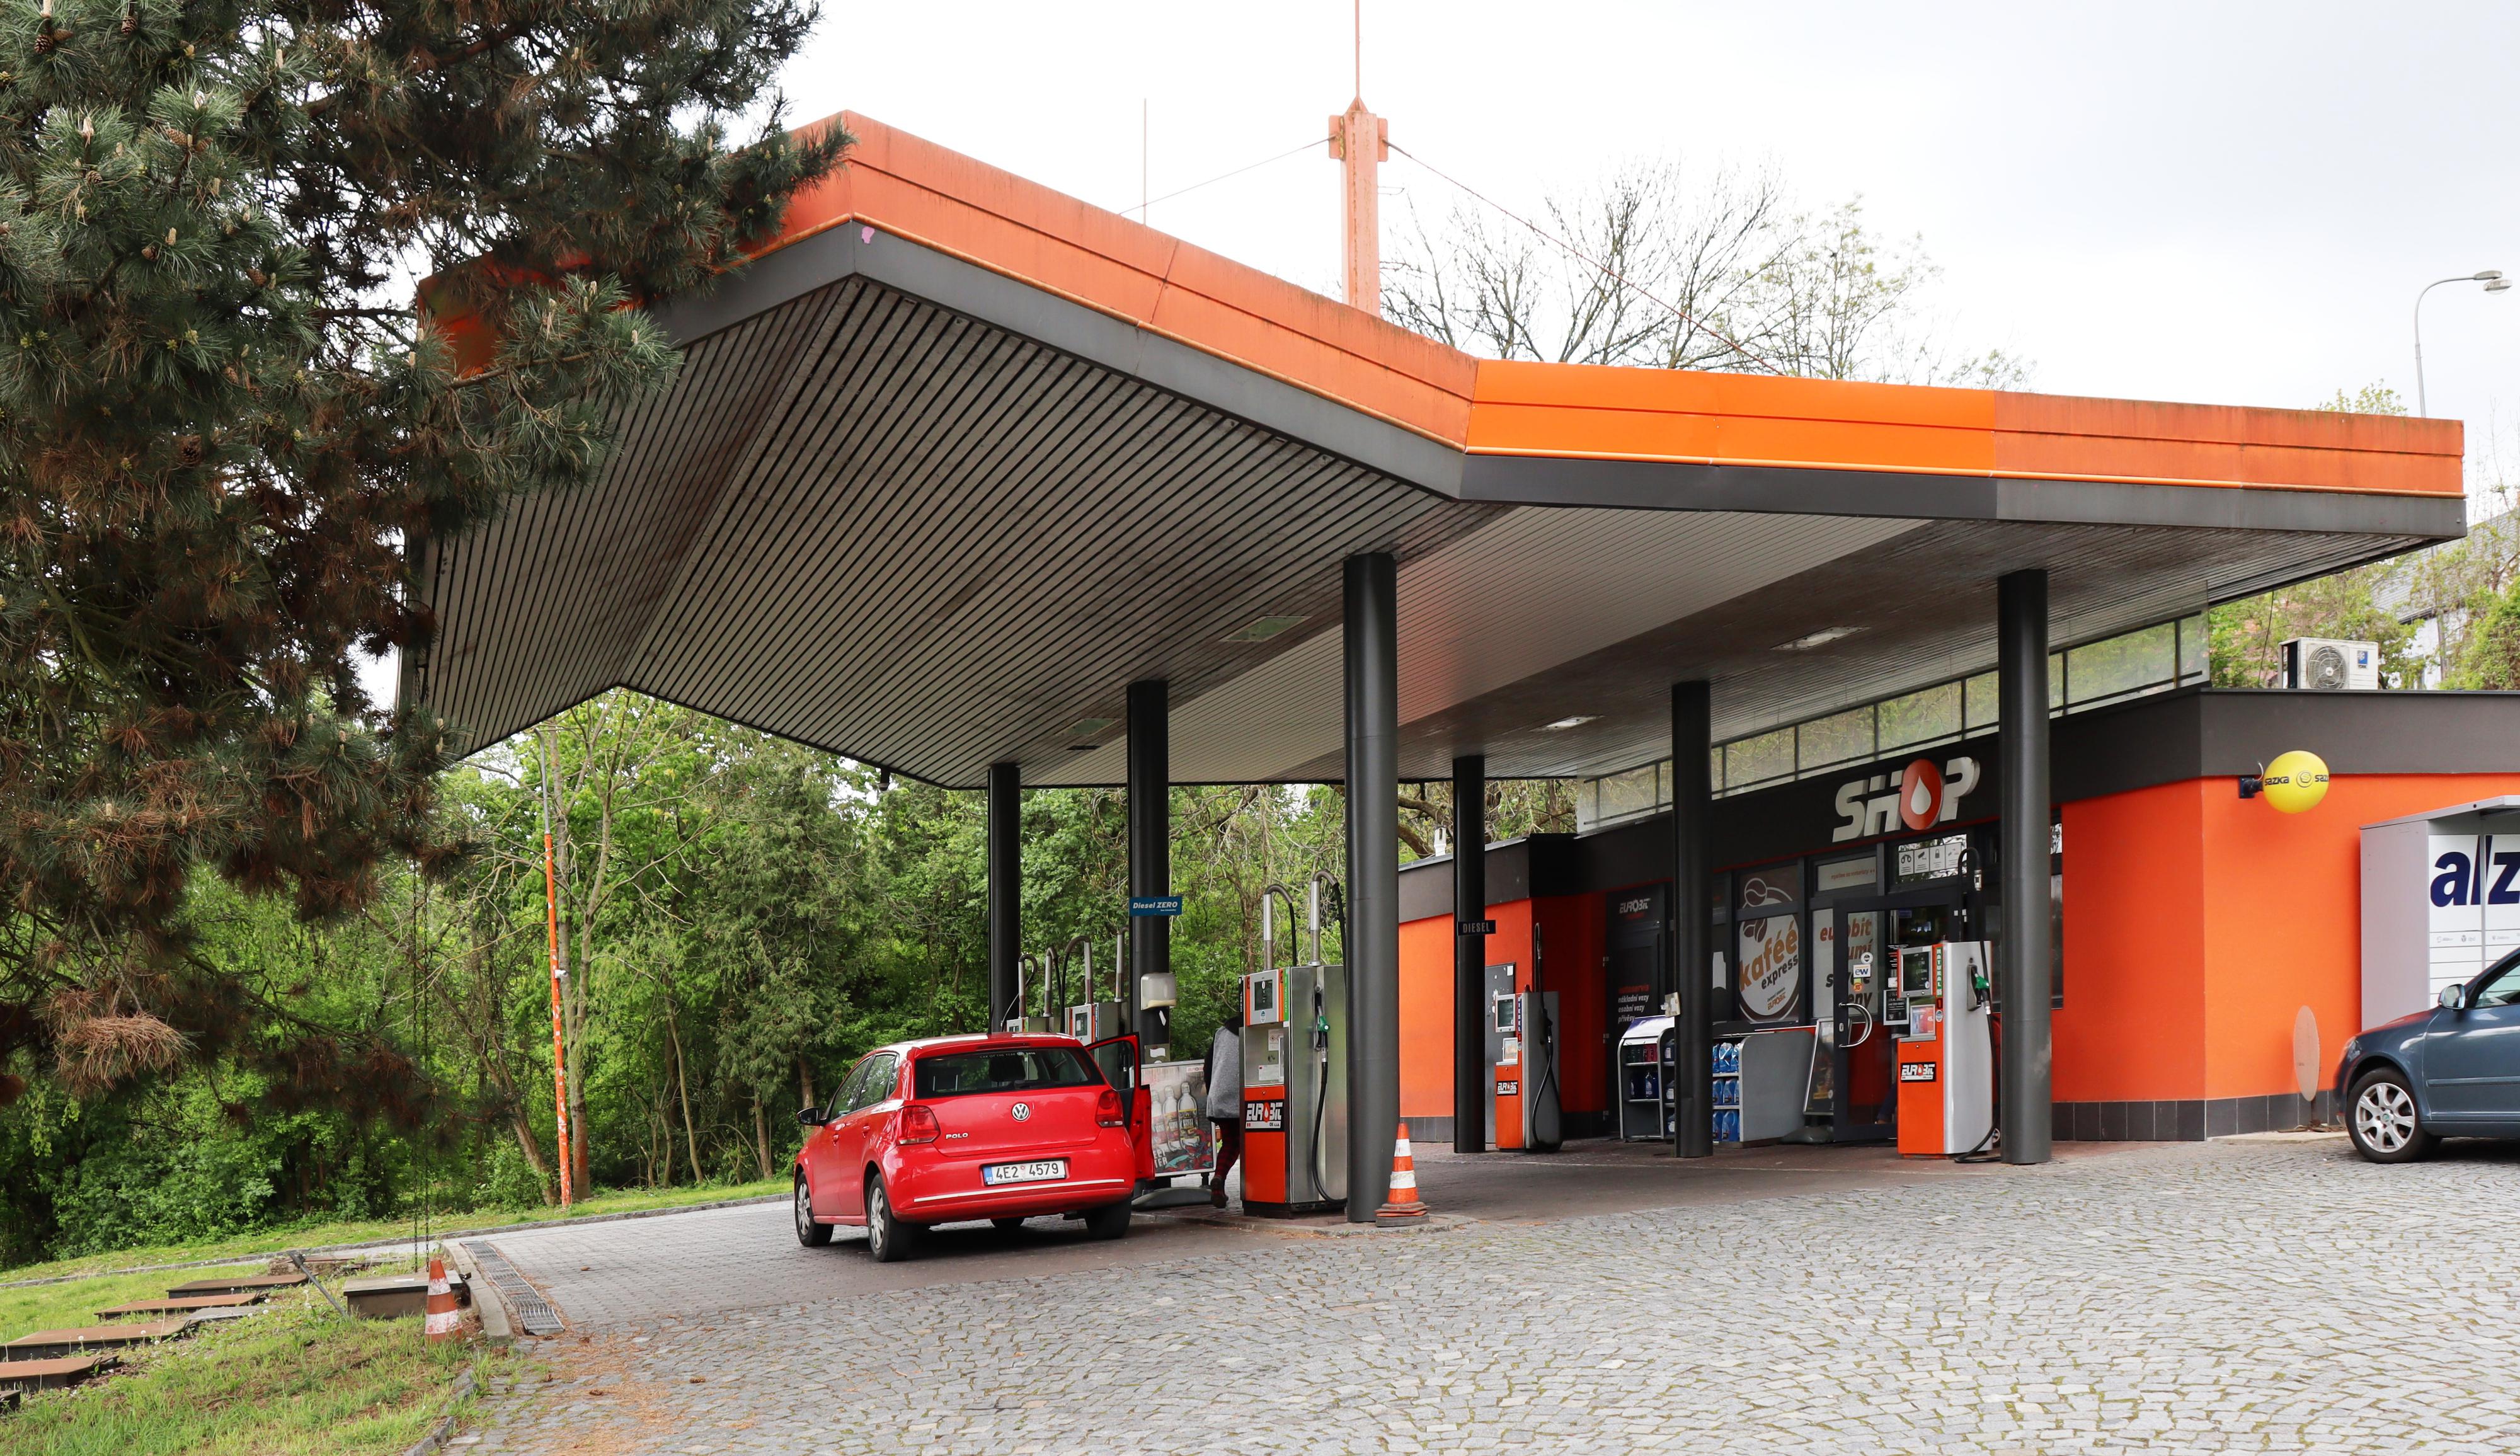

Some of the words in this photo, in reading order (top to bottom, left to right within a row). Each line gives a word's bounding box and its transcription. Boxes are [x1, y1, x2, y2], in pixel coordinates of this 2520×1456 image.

[1832, 756, 1980, 843] SHOP
[1619, 898, 1651, 914] EUROBIT
[1463, 922, 1491, 933] DIESEL
[1820, 917, 1872, 942] eubit
[1761, 954, 1799, 990] express
[1901, 1063, 1935, 1077] EUROBIT
[1498, 1082, 1518, 1091] EUROBIT
[1246, 1102, 1283, 1122] EUROBIT
[996, 1166, 1019, 1179] 4E2
[1029, 1162, 1059, 1176] 4579
